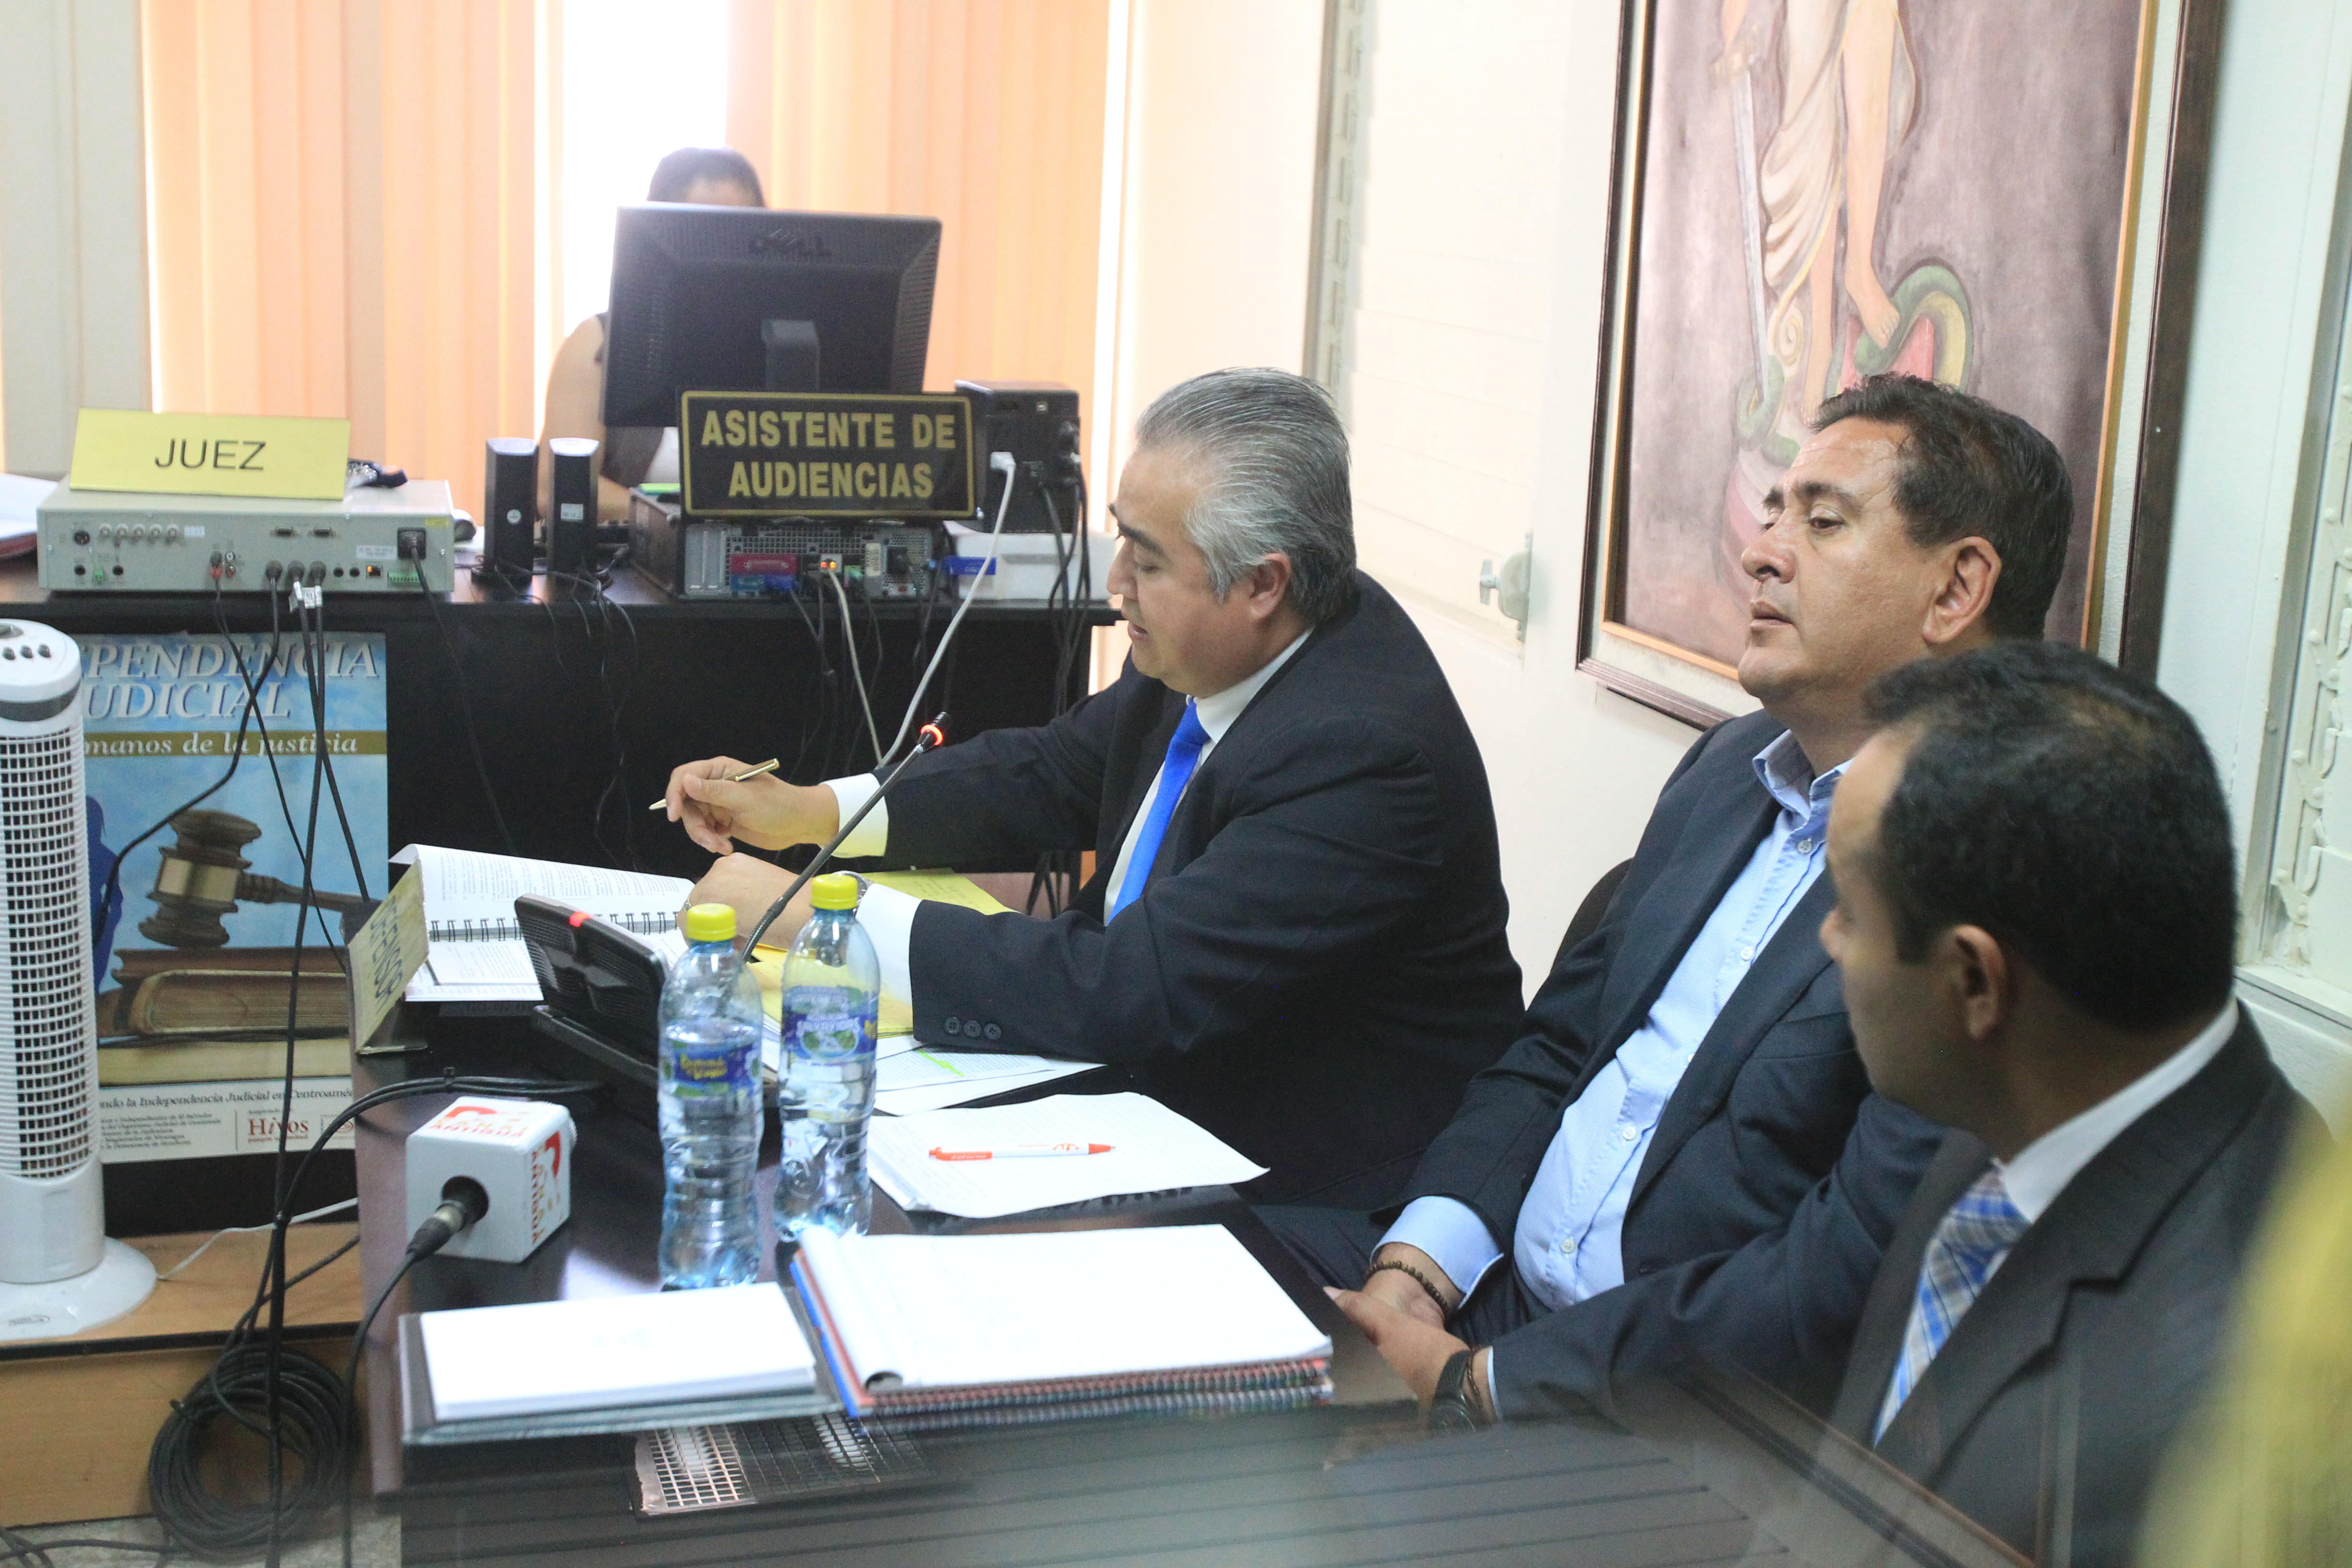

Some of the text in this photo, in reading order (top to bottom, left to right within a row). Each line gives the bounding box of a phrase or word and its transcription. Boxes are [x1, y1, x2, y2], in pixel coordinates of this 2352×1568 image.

[700, 409, 956, 449] ASISTENTE DE
[154, 437, 266, 470] JUEZ
[728, 461, 934, 498] AUDIENCIAS
[80, 642, 380, 679] PENDENCIA
[182, 731, 213, 755] de
[223, 731, 249, 755] la
[257, 732, 357, 758] justiia
[140, 1093, 223, 1107] Independencia
[225, 1090, 270, 1103] Judicial
